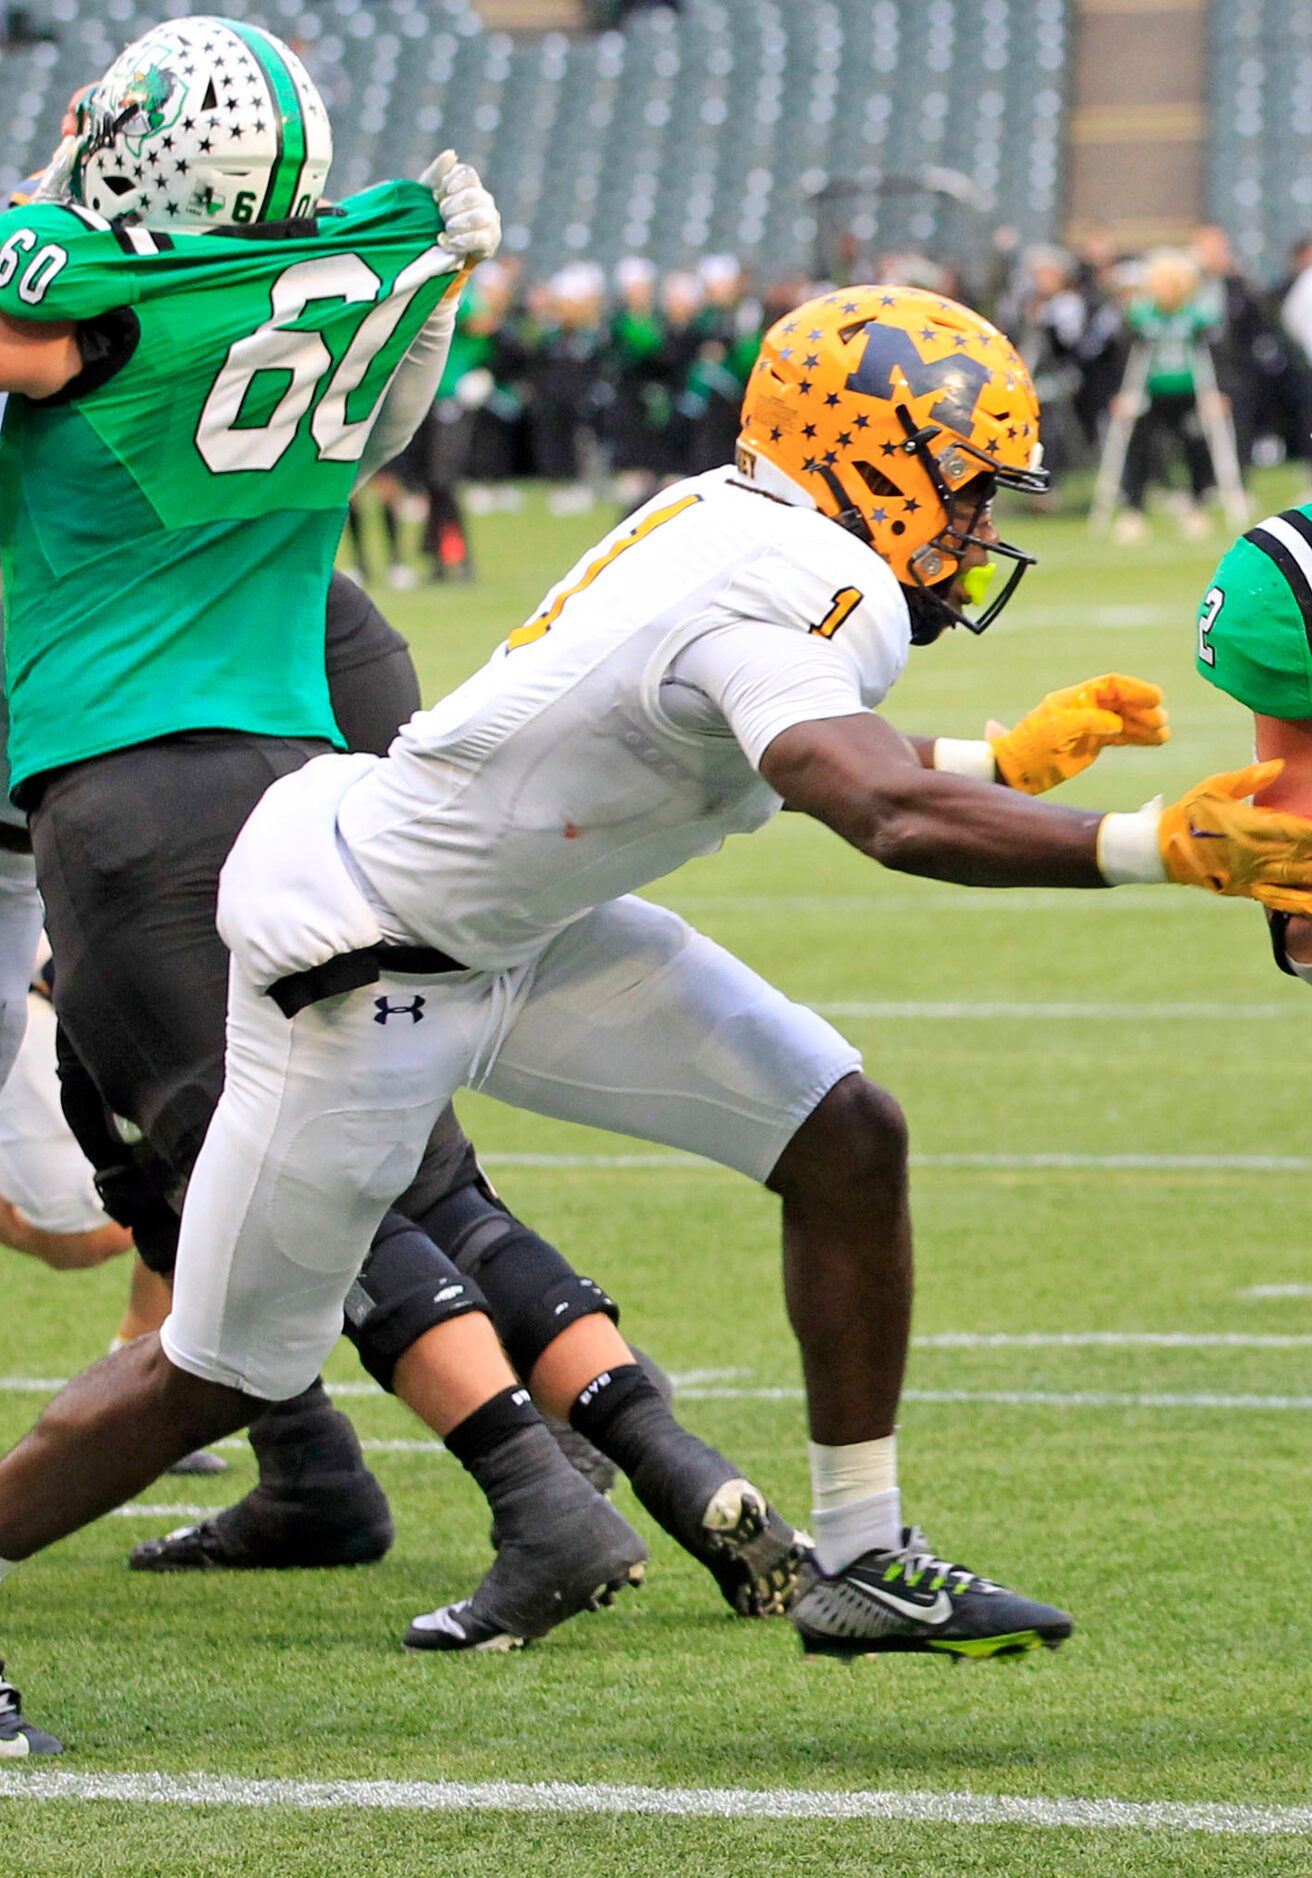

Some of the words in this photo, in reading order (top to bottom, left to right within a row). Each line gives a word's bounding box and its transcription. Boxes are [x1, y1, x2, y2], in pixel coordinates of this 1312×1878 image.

[231, 190, 257, 223] 6
[0, 227, 69, 306] 60
[844, 321, 994, 440] M
[505, 493, 705, 657] 1
[808, 585, 865, 641] 1
[1198, 586, 1226, 669] 2
